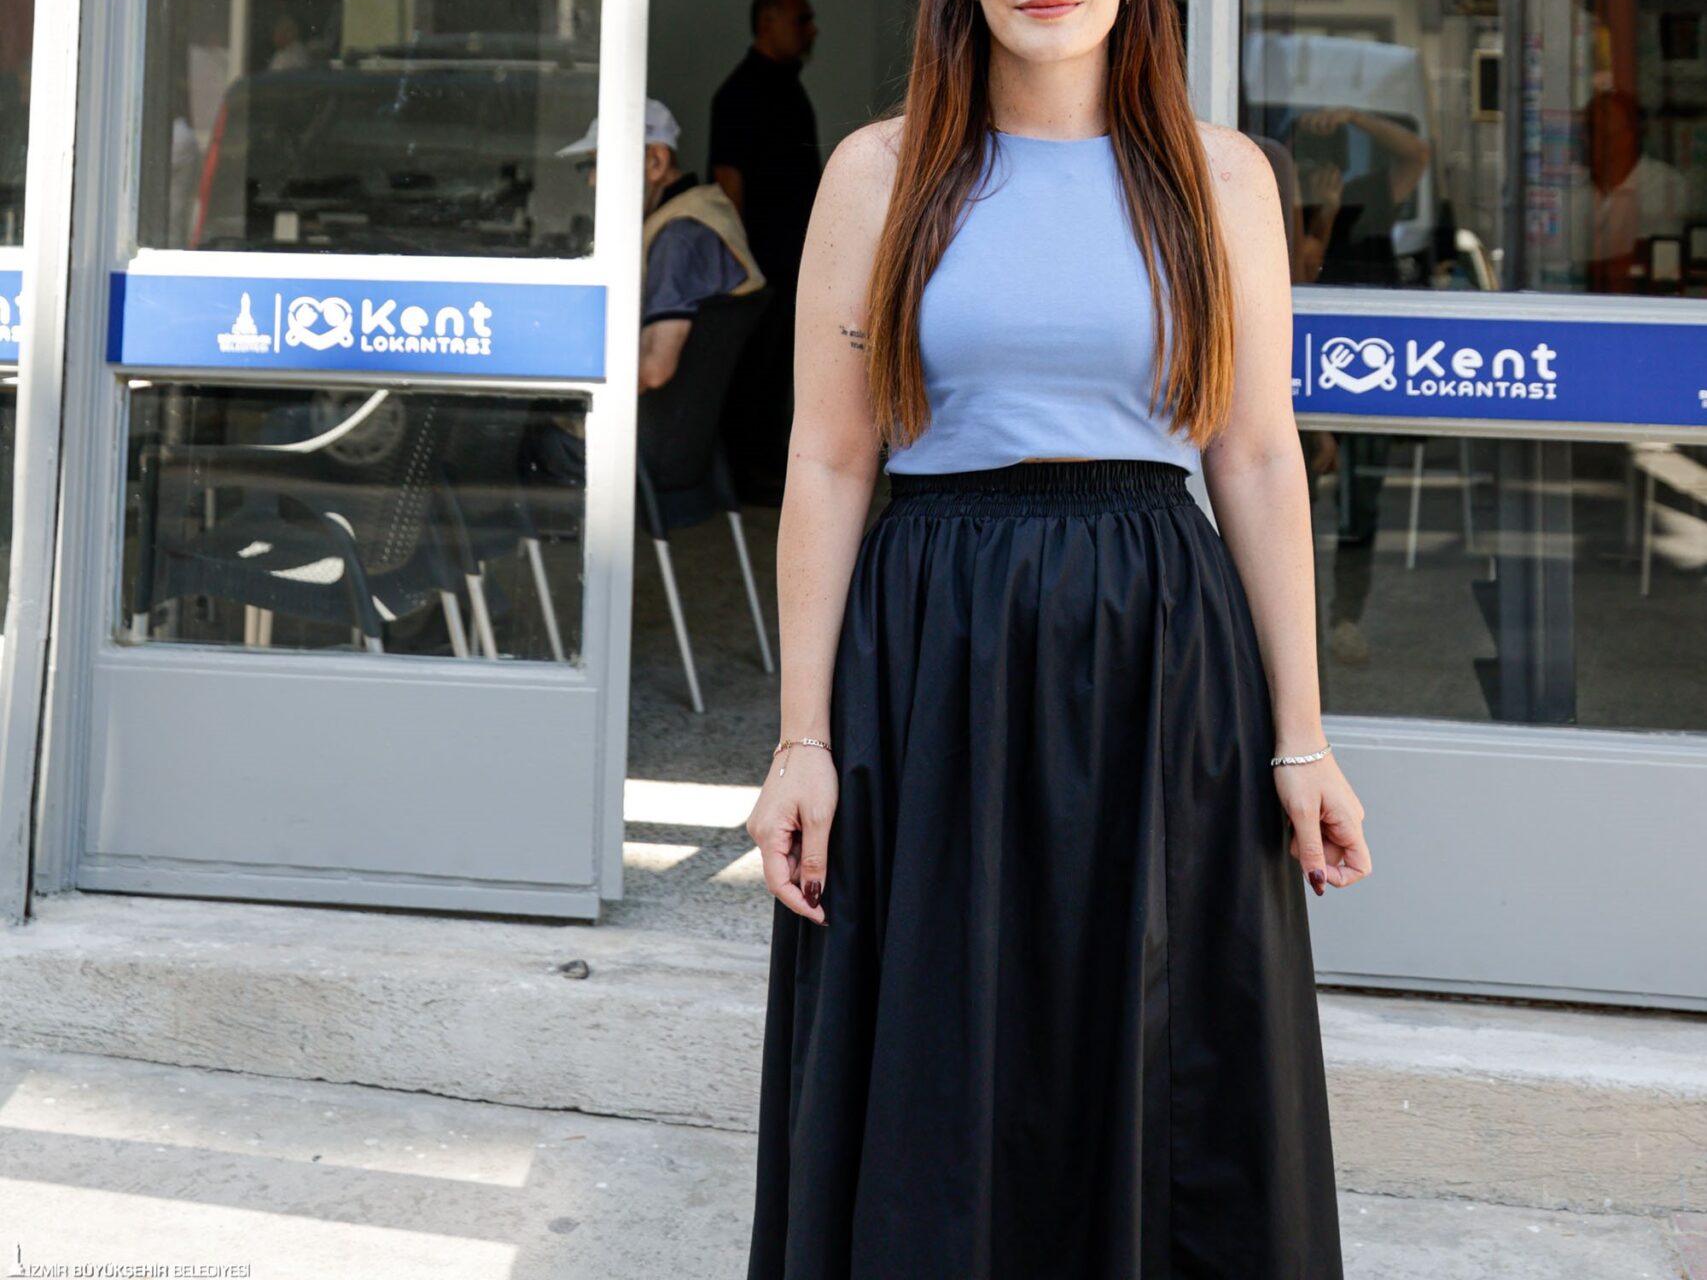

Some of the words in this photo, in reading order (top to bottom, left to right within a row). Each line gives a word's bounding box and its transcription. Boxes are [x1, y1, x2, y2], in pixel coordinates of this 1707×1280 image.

[361, 298, 493, 338] Kent
[360, 335, 492, 356] LOKANTASI
[1406, 339, 1558, 381] Kent
[1406, 378, 1558, 400] LOKANTASI
